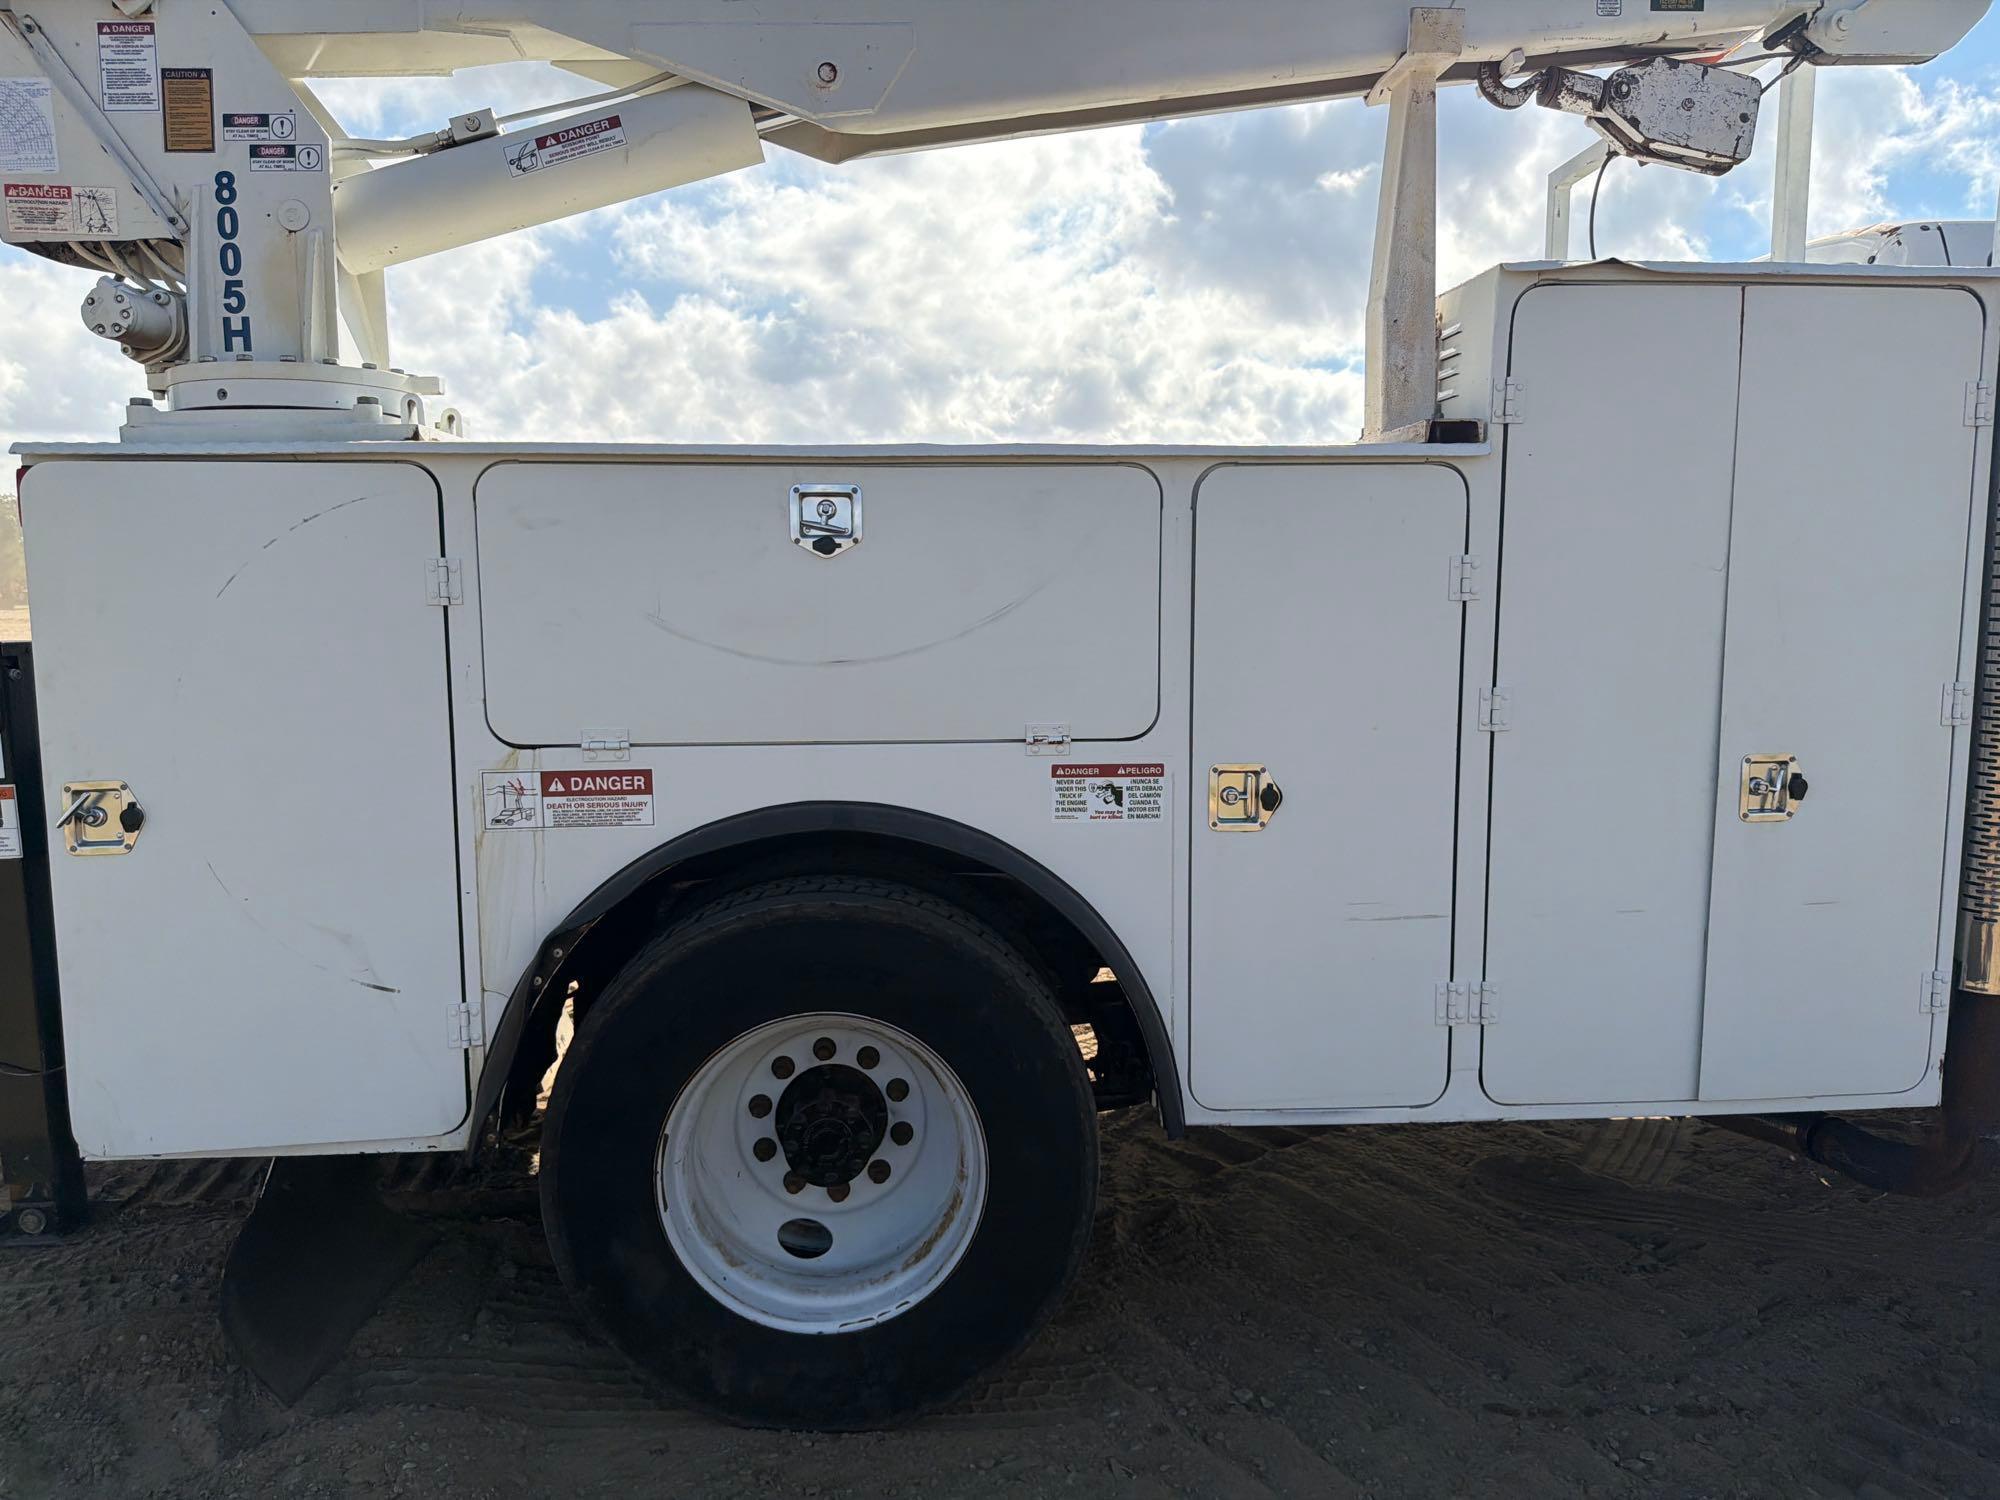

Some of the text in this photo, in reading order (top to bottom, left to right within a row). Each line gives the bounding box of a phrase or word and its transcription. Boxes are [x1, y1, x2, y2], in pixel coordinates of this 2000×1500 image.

[559, 120, 610, 142] DANGER
[549, 149, 569, 158] SERIOUS
[599, 136, 616, 144] RESULT
[562, 135, 600, 149] SCISSORS POINT
[18, 187, 68, 198] DANGER
[215, 171, 252, 352] 8005H
[571, 776, 645, 791] DANGER
